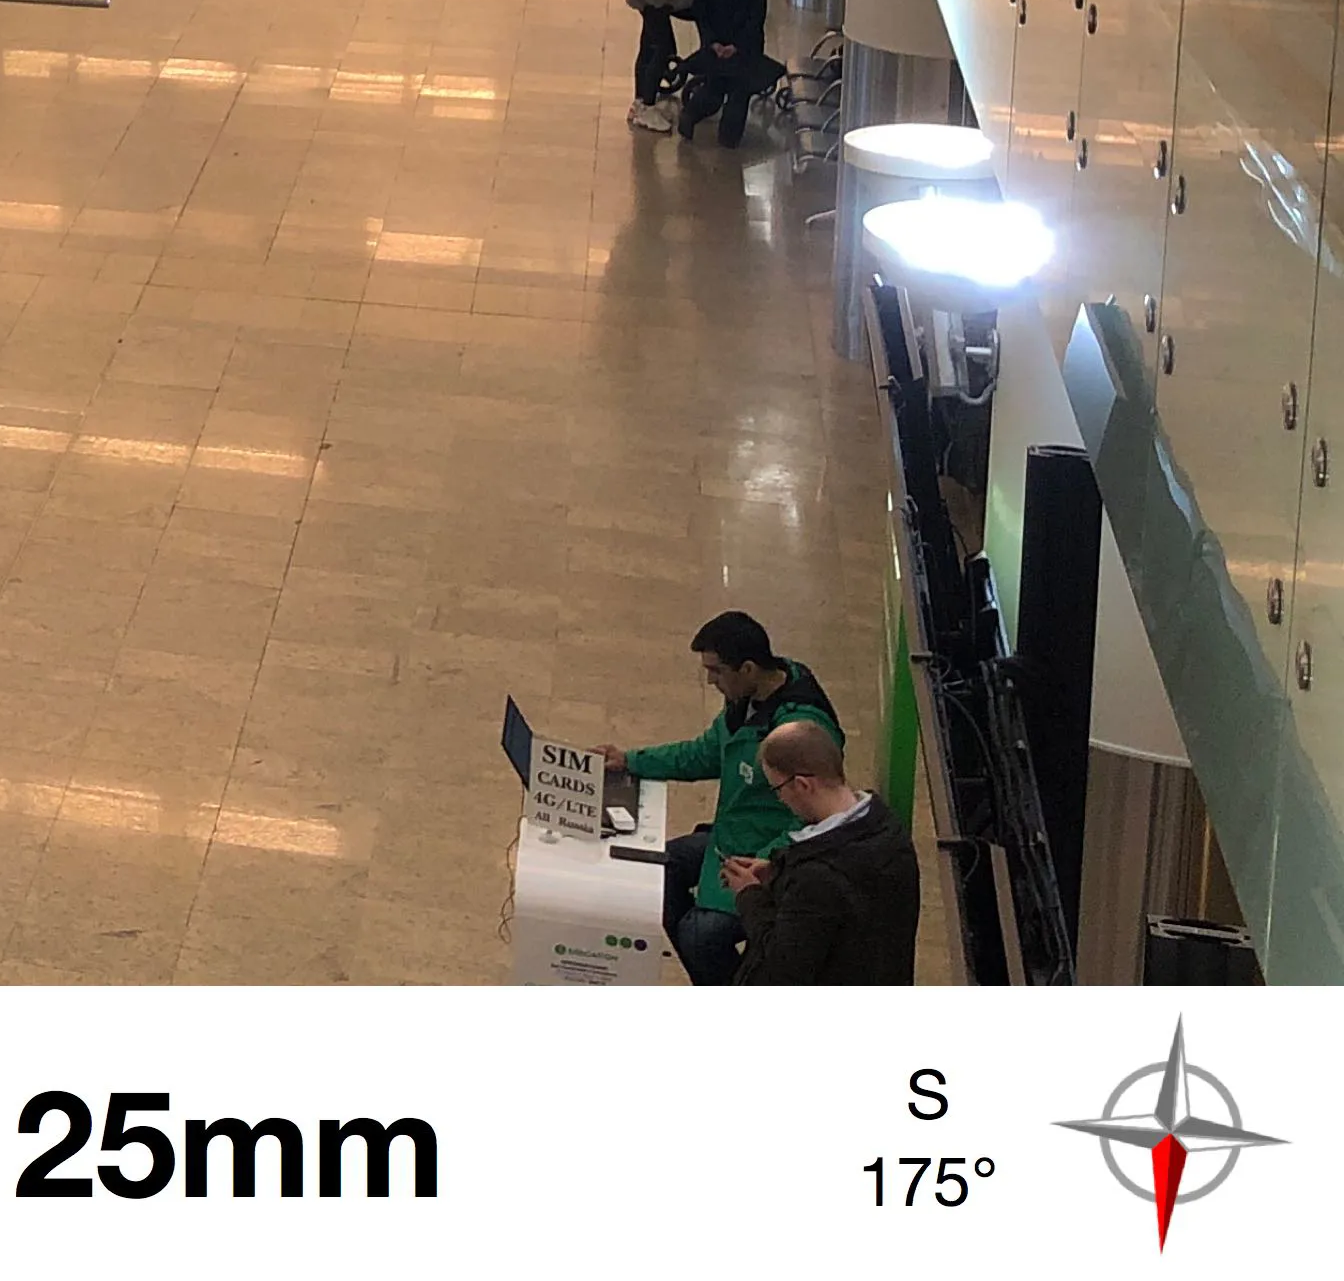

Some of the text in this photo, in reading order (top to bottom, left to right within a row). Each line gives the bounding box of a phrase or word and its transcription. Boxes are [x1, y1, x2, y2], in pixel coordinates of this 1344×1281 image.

[542, 744, 593, 775] SIM
[537, 770, 596, 797] CARDS
[533, 791, 598, 819] 4G/LTE
[534, 811, 594, 834] All Russia
